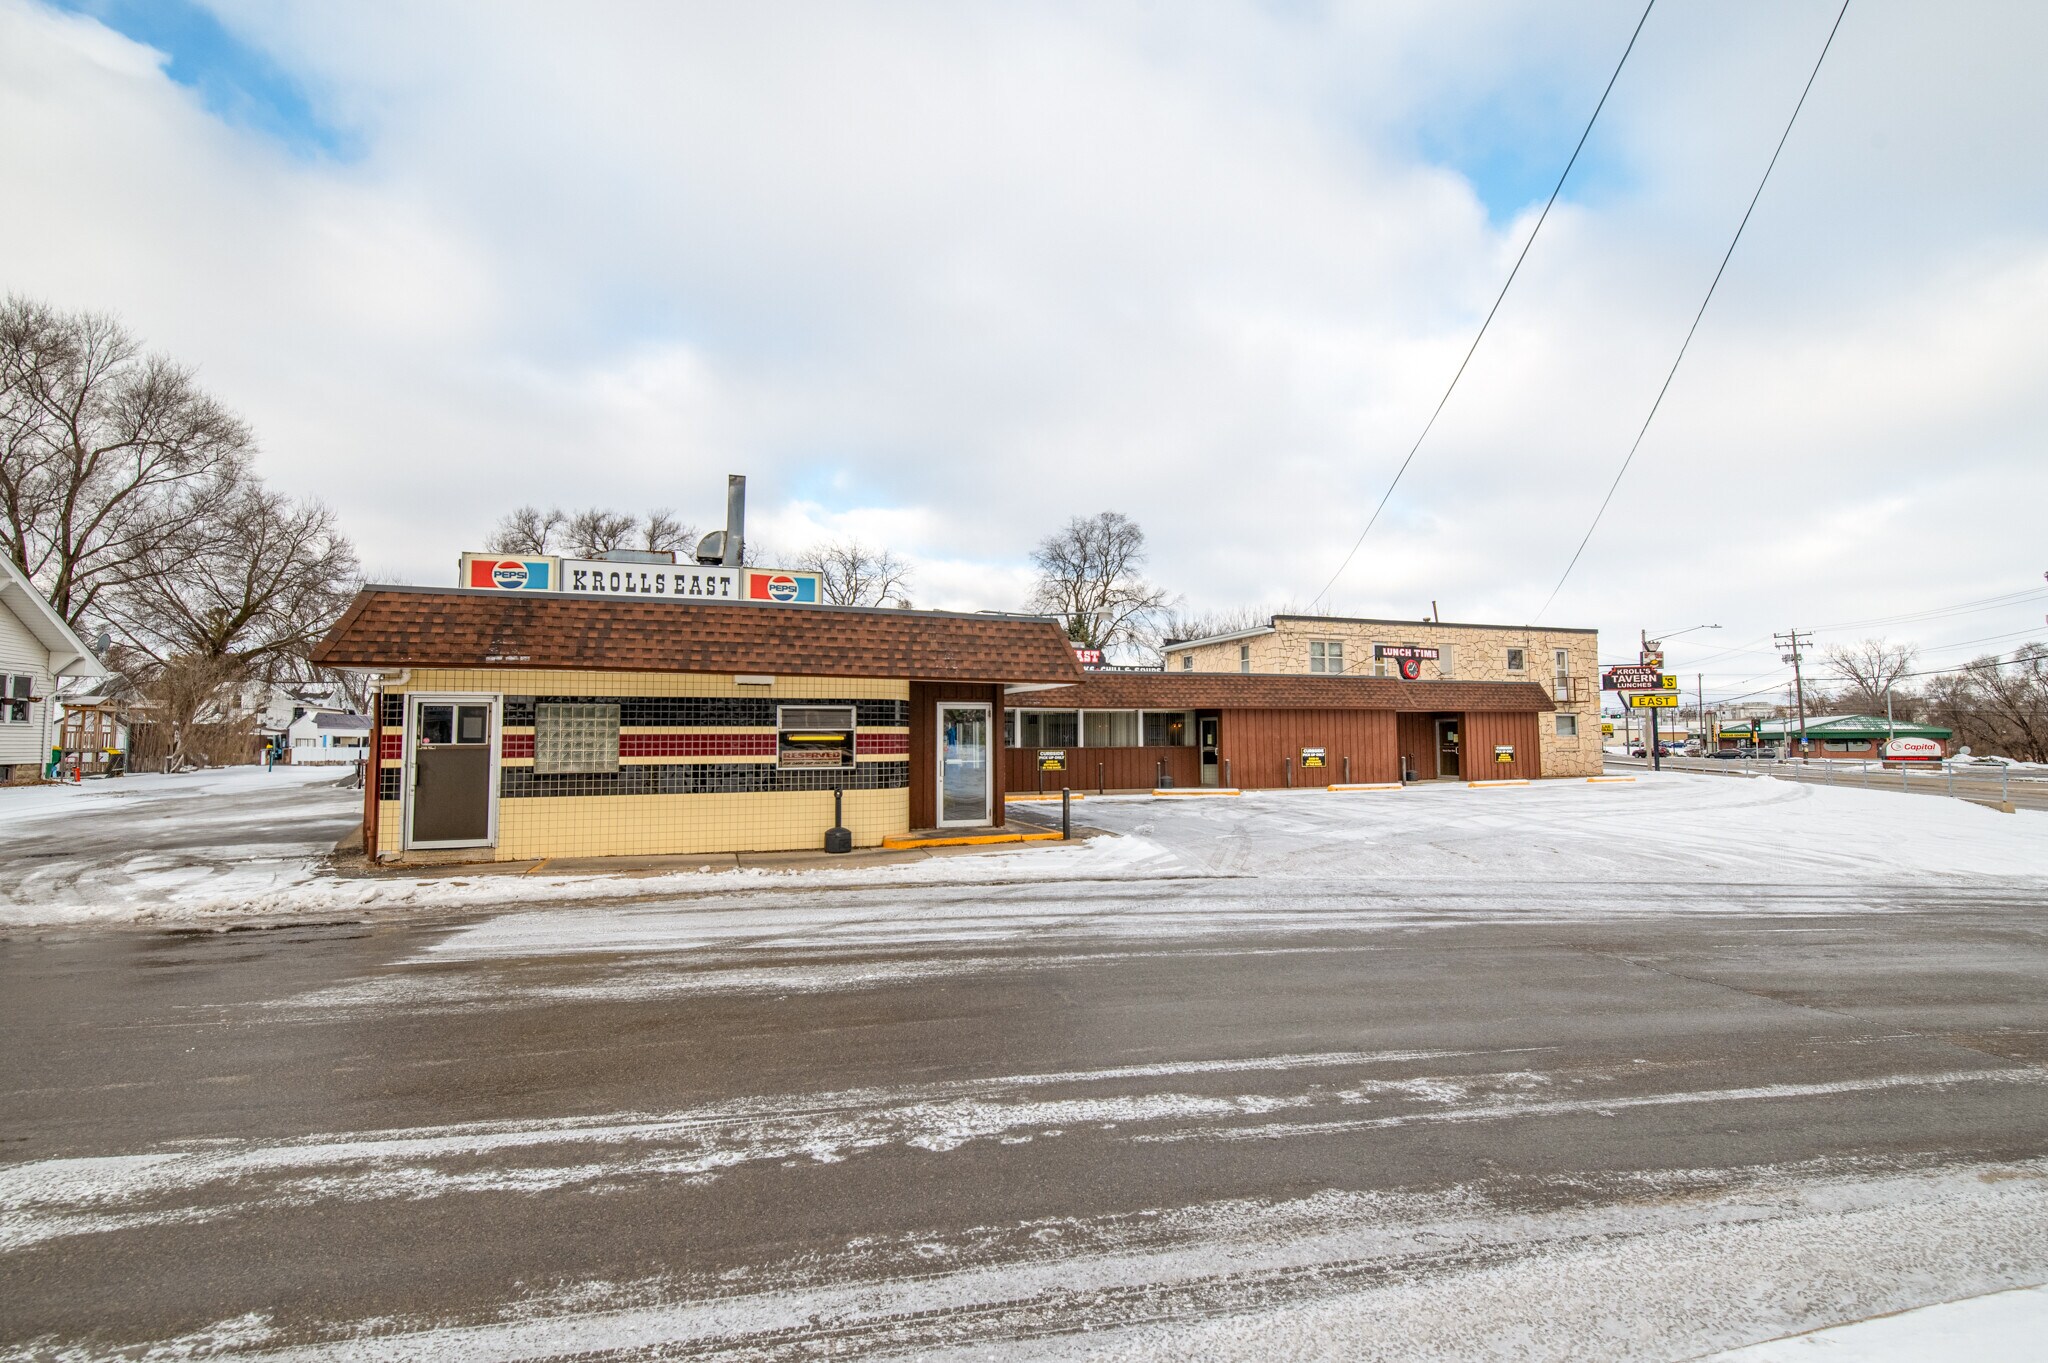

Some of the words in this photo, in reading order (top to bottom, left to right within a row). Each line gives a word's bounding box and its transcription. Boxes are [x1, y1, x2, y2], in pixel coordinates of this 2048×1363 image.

[493, 570, 528, 580] PEPSI
[573, 570, 665, 594] KROLLS
[674, 574, 731, 596] EAST
[769, 583, 798, 593] PEPSI
[1074, 650, 1100, 663] AST
[1382, 647, 1412, 657] LUNCH
[1413, 648, 1438, 658] TIME
[1611, 675, 1657, 683] TAVERN
[1639, 697, 1670, 706] EAST
[1904, 743, 1936, 751] Capital
